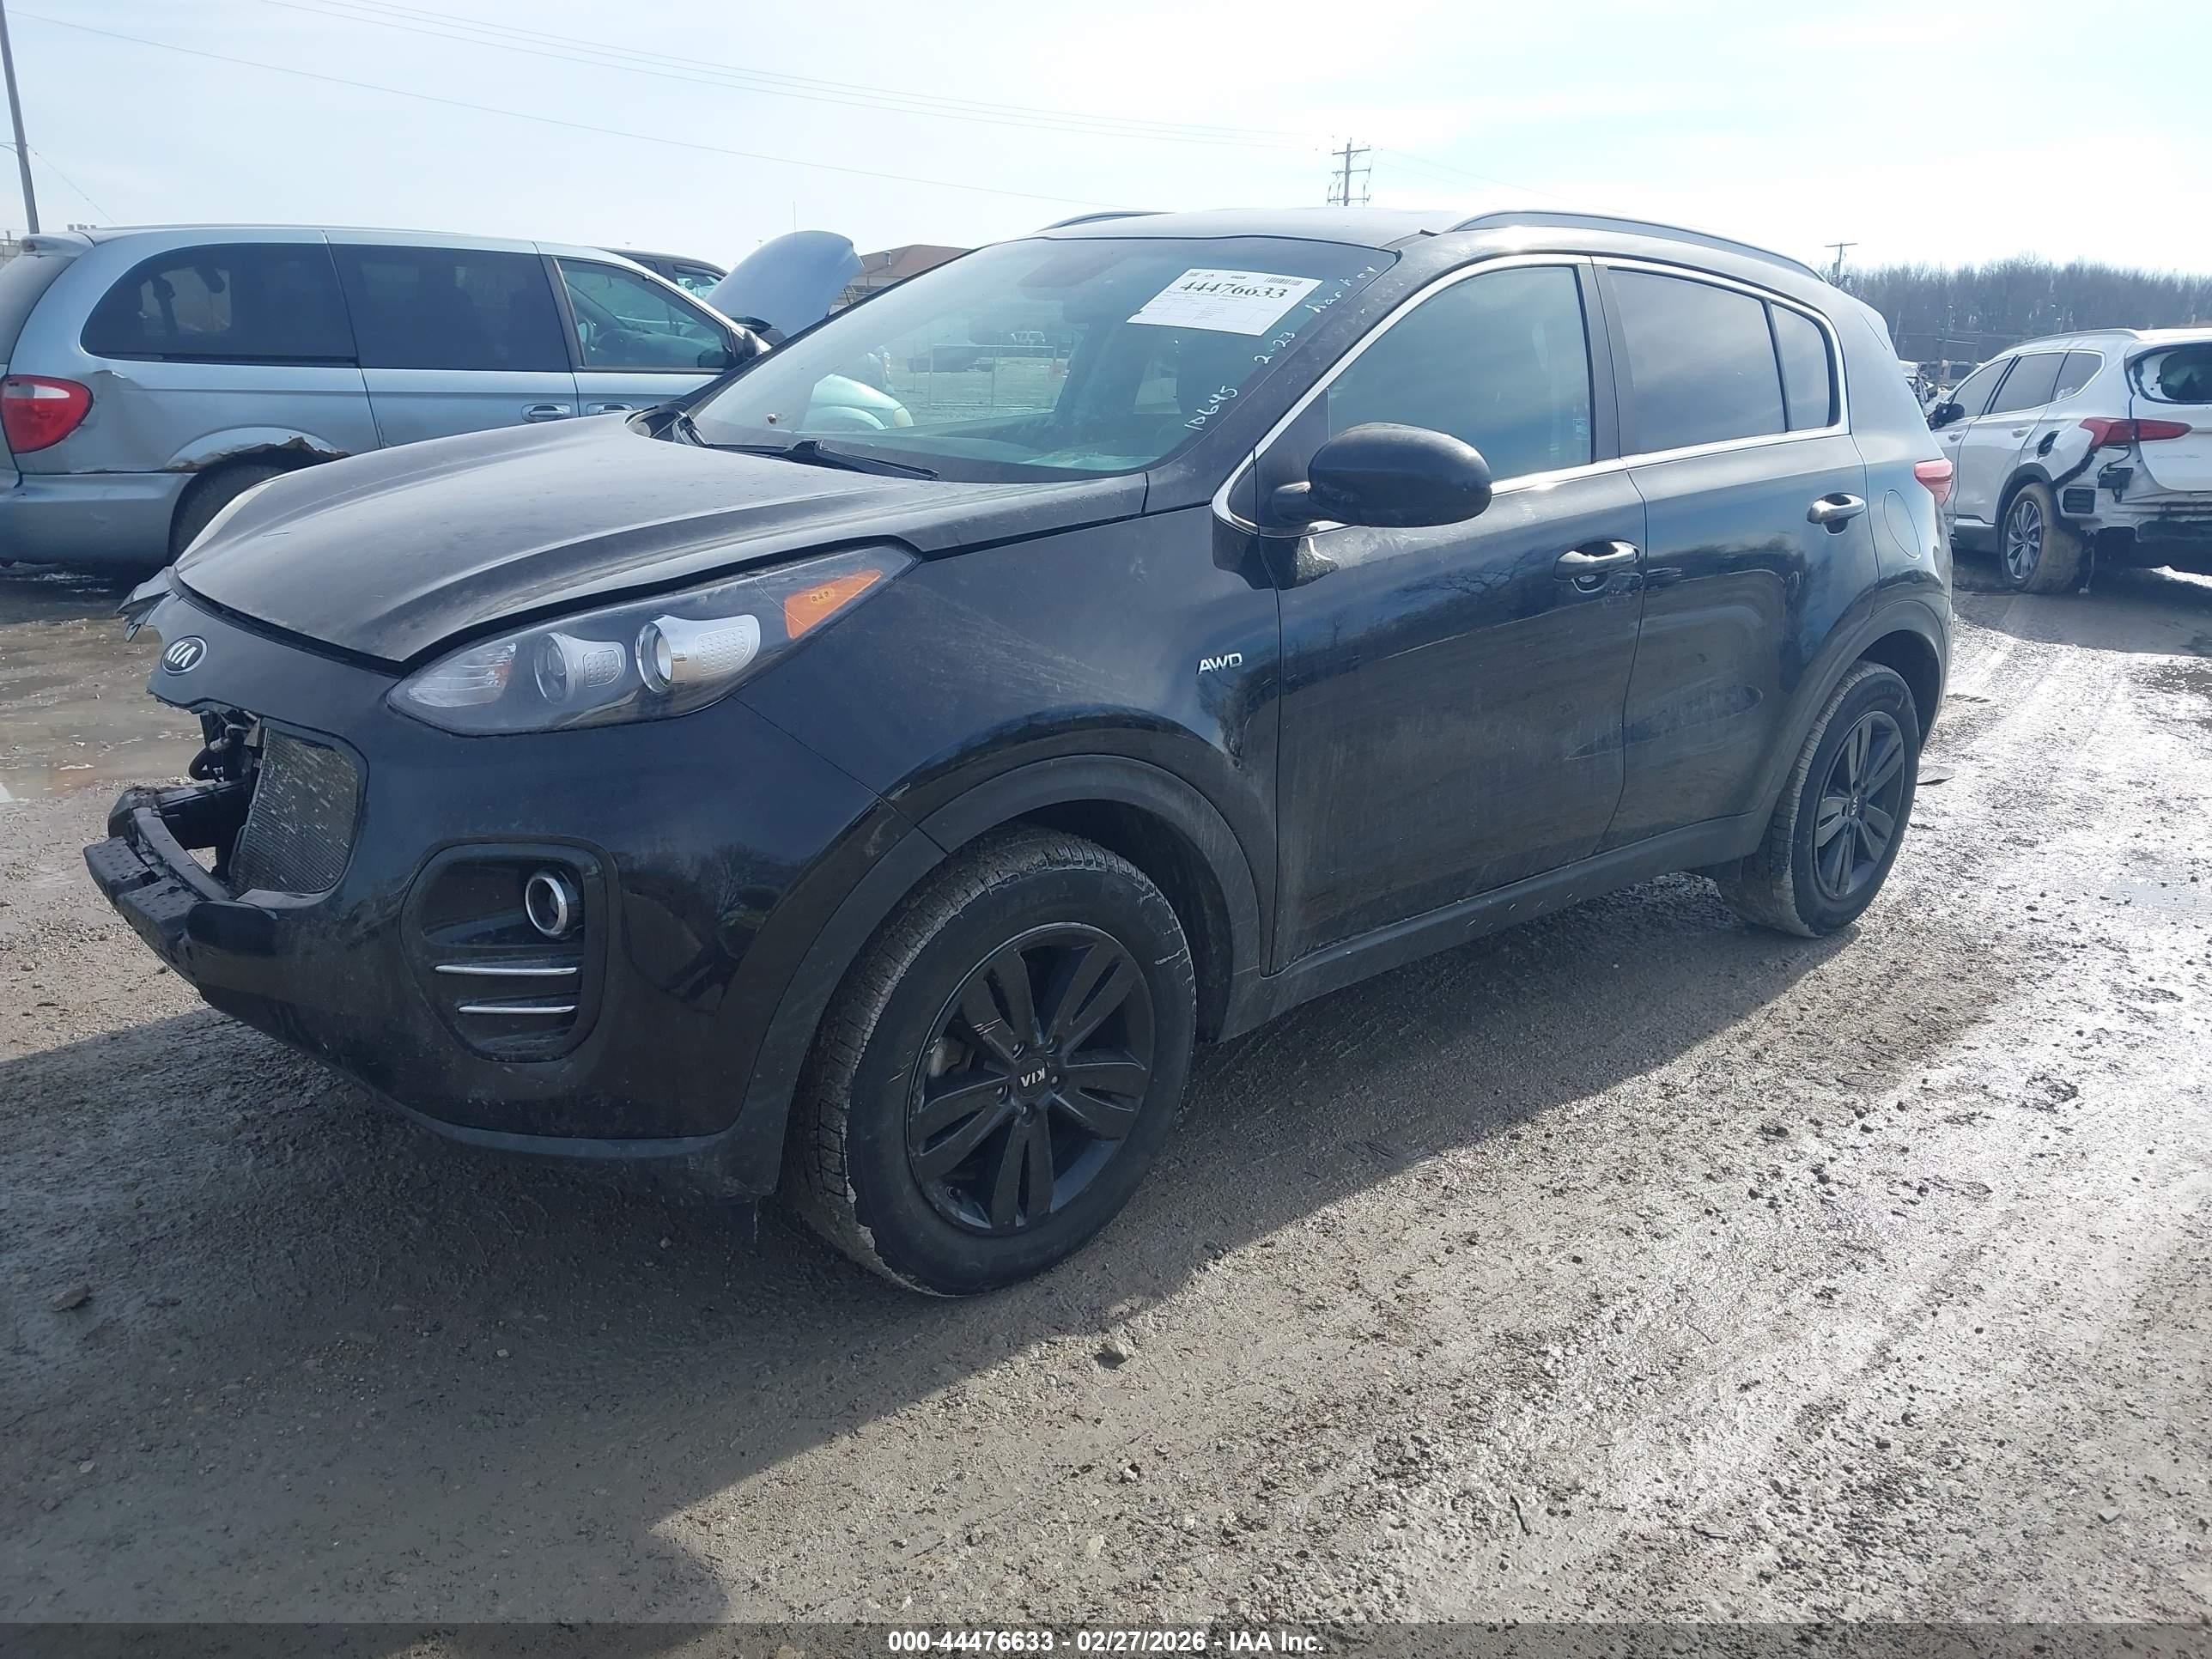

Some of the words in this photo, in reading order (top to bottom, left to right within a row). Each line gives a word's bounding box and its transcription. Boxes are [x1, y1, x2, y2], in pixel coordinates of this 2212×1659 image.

[1179, 281, 1289, 300] 44476633
[1184, 385, 1238, 431] 10645
[1254, 331, 1296, 364] 2-23
[166, 641, 198, 668] KIA
[1197, 653, 1243, 674] AWD
[1020, 1066, 1046, 1087] KIA
